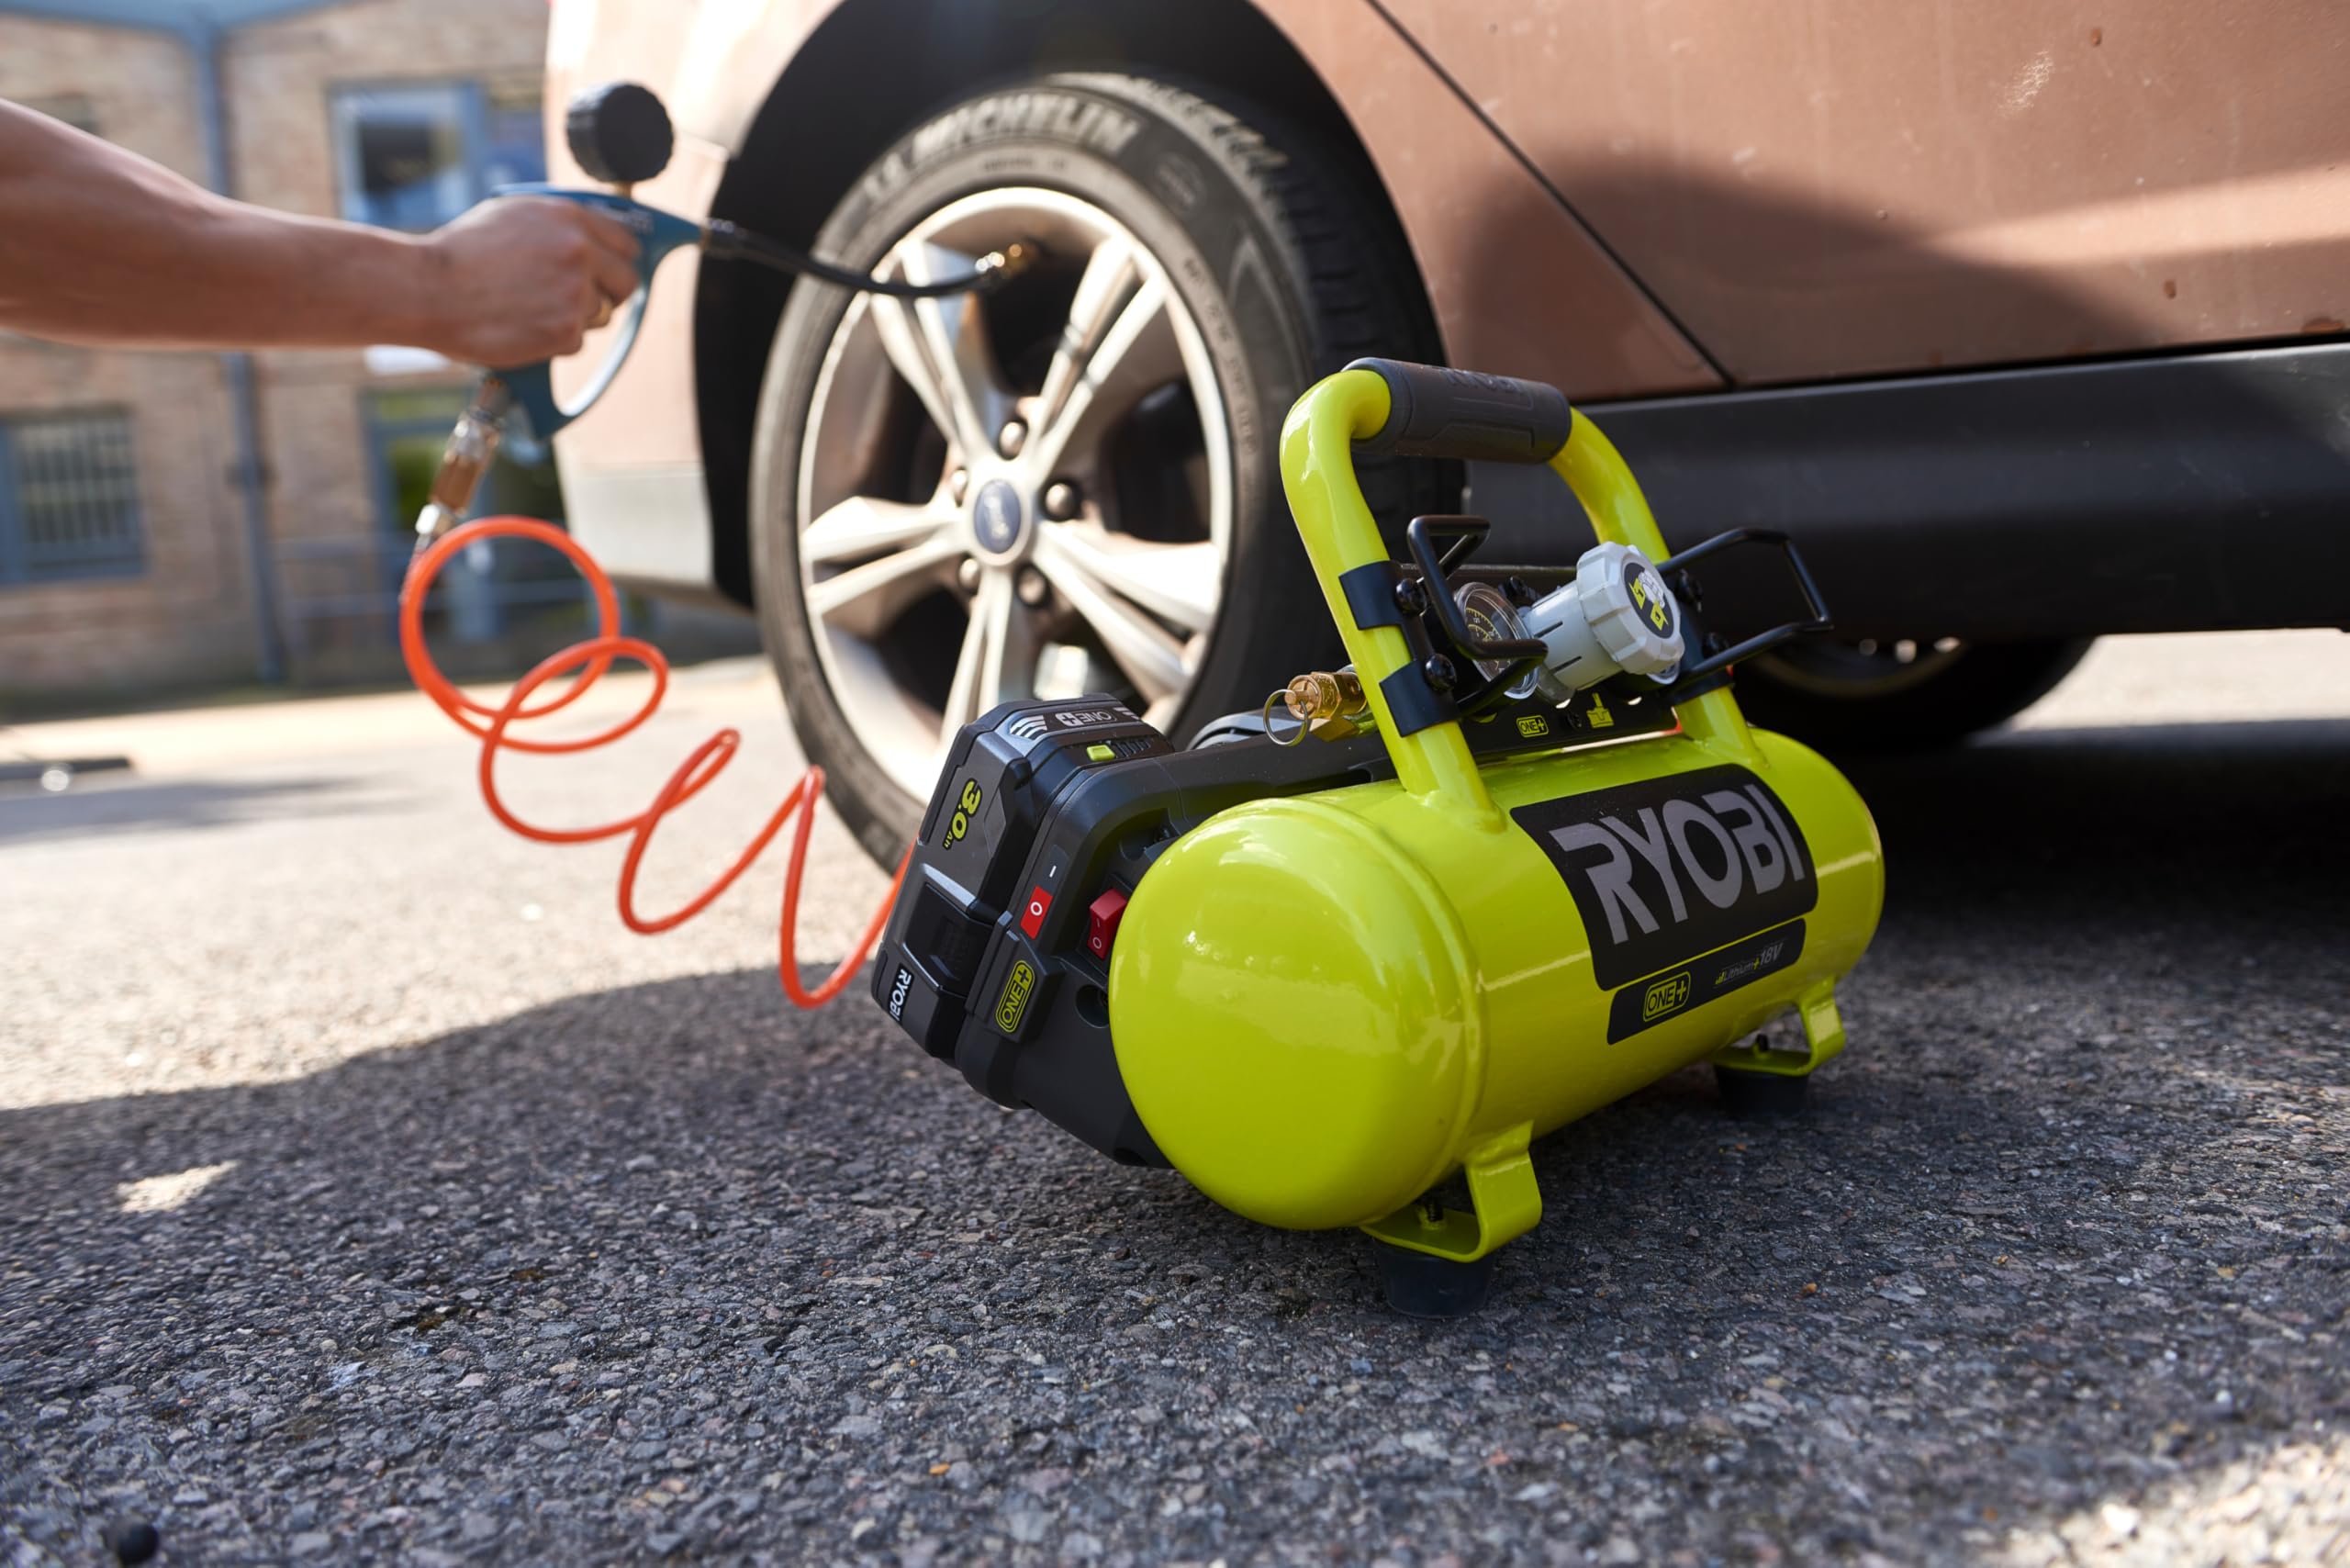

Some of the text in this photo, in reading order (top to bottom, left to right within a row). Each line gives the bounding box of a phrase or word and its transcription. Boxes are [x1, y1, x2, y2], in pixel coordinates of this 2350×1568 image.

[1550, 784, 1805, 945] RYOBI
[890, 969, 912, 1022] RYOBI
[1002, 969, 1030, 1025] ONE+
[1647, 980, 1687, 1012] ONE+
